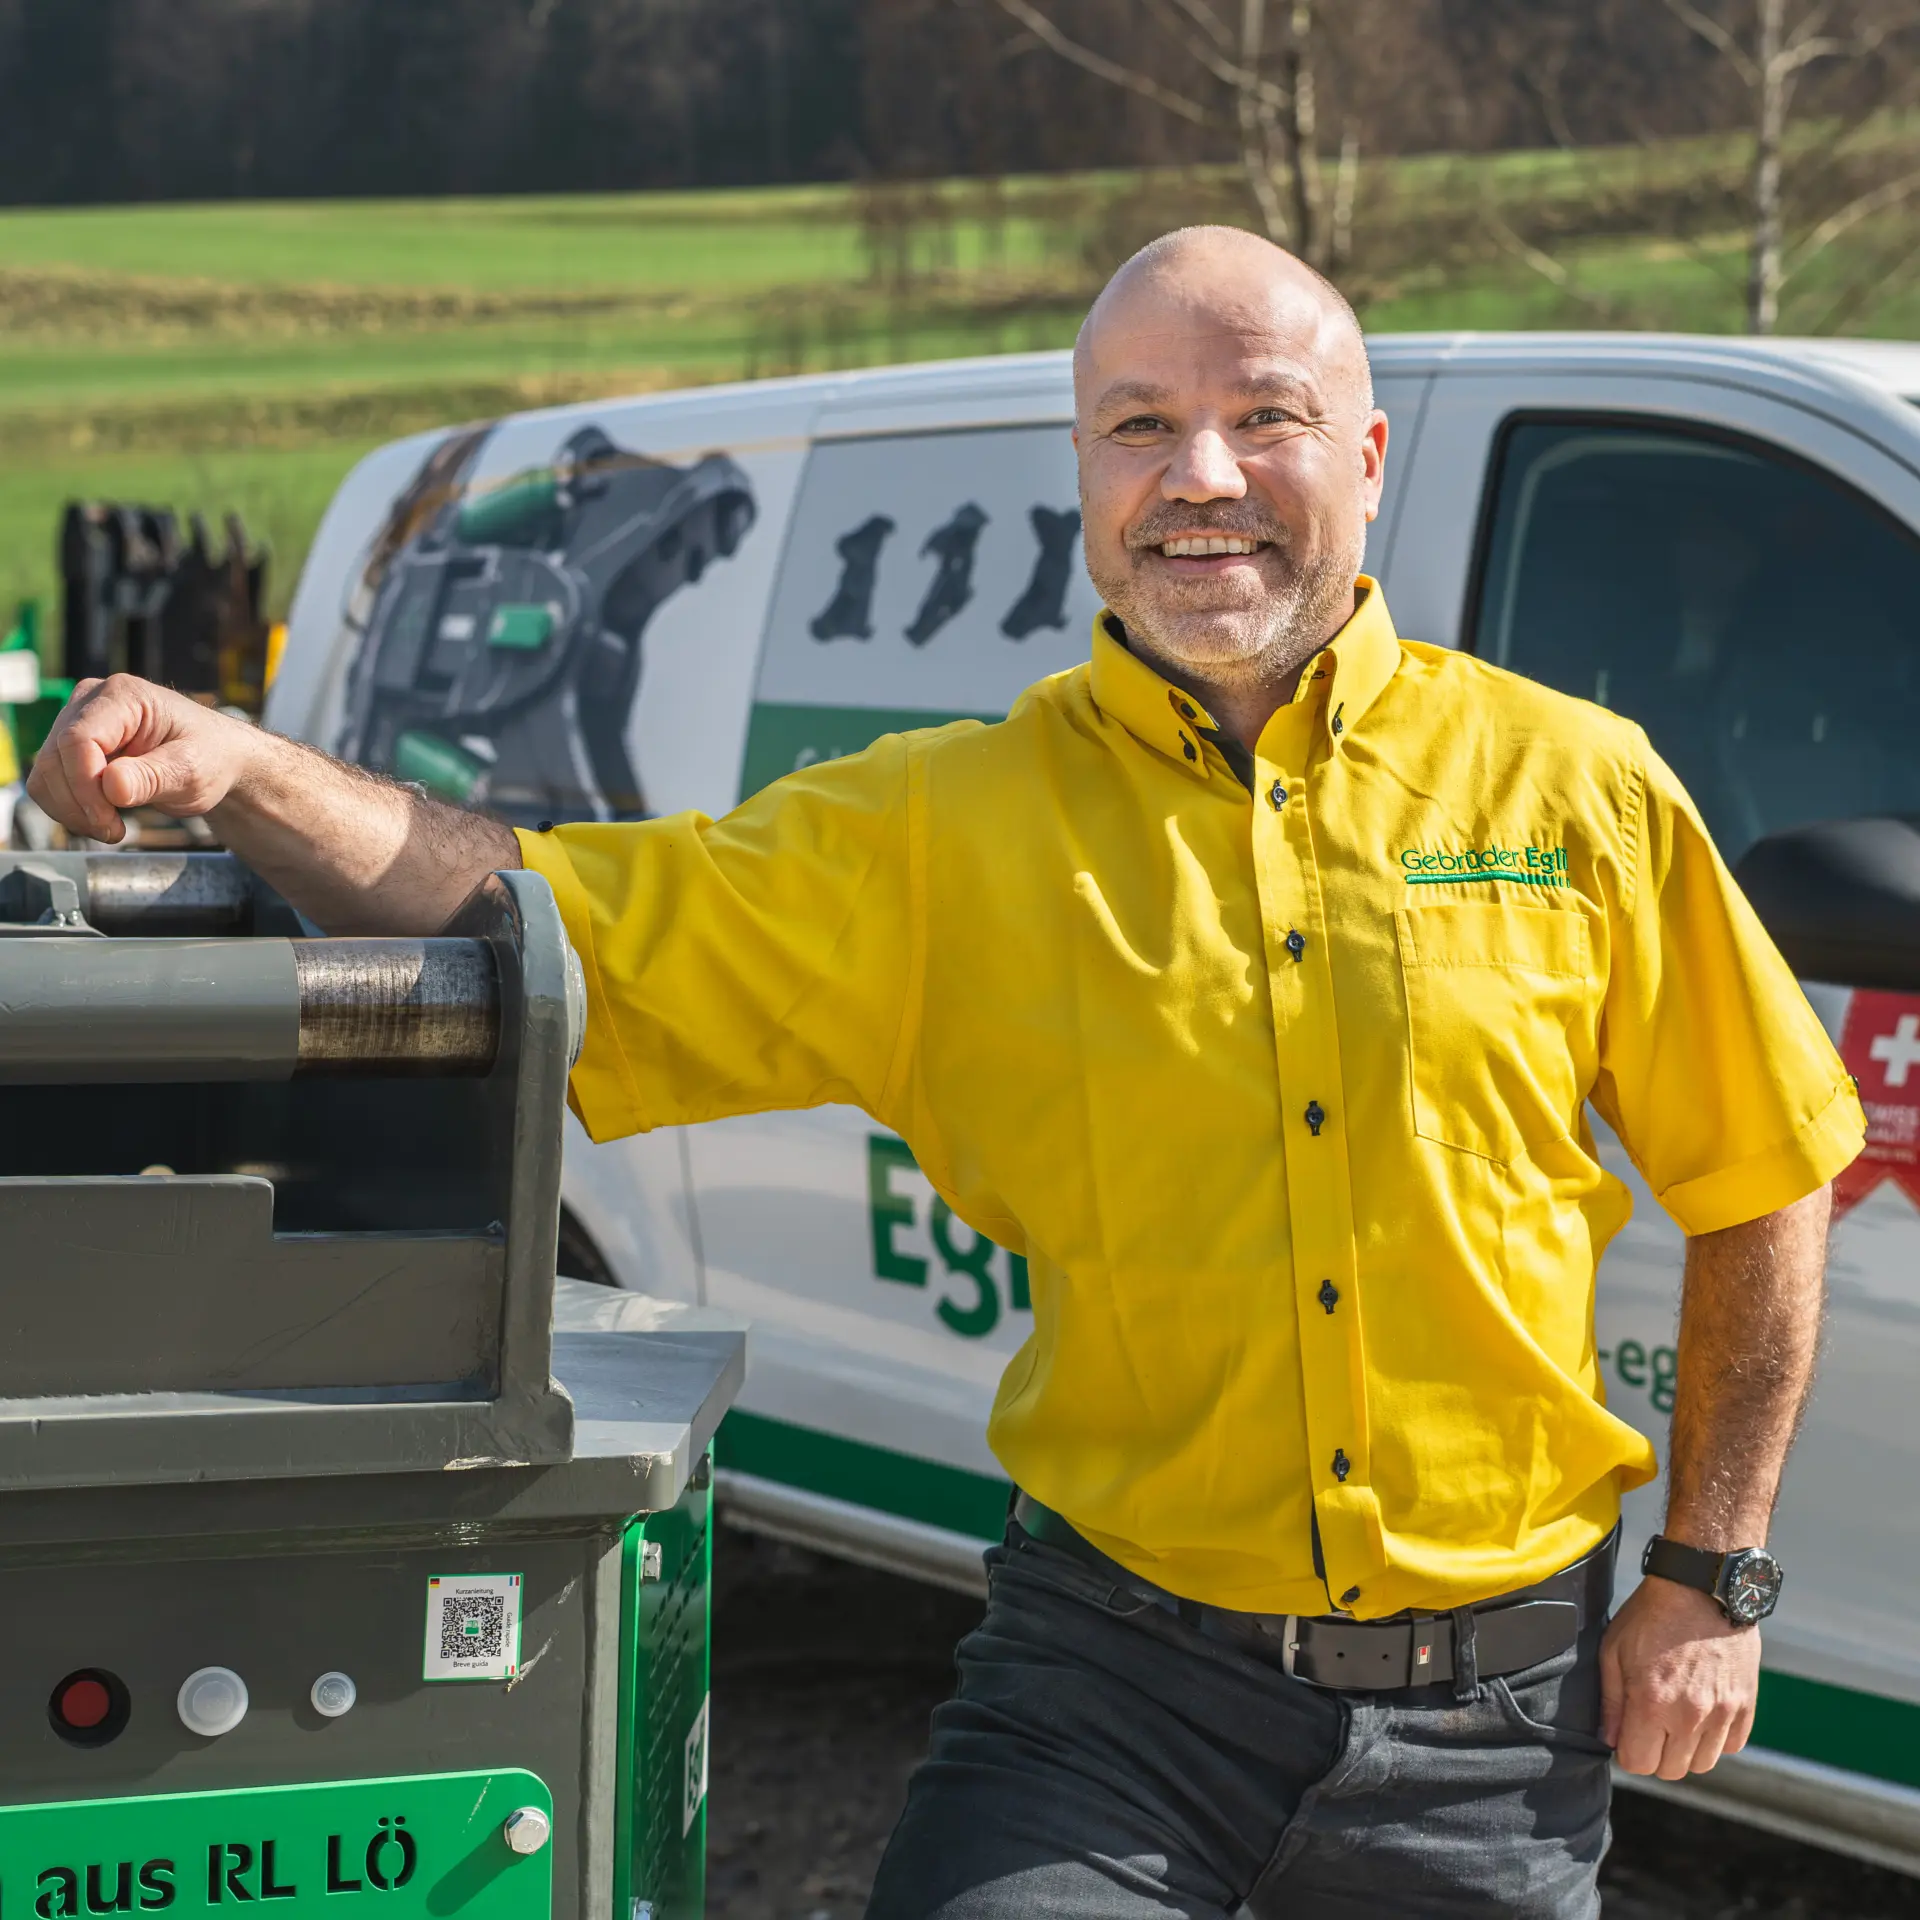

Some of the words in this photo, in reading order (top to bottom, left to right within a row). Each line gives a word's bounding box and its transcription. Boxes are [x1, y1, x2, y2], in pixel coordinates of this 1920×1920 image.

[1400, 845, 1519, 870] Gebrüder
[1525, 847, 1568, 874] Egli
[504, 1629, 512, 1648] rapide
[453, 1660, 471, 1668] Breve
[471, 1660, 489, 1669] guida
[34, 1858, 177, 1920] aus
[206, 1839, 297, 1906] RL
[325, 1815, 417, 1896] LÖ
